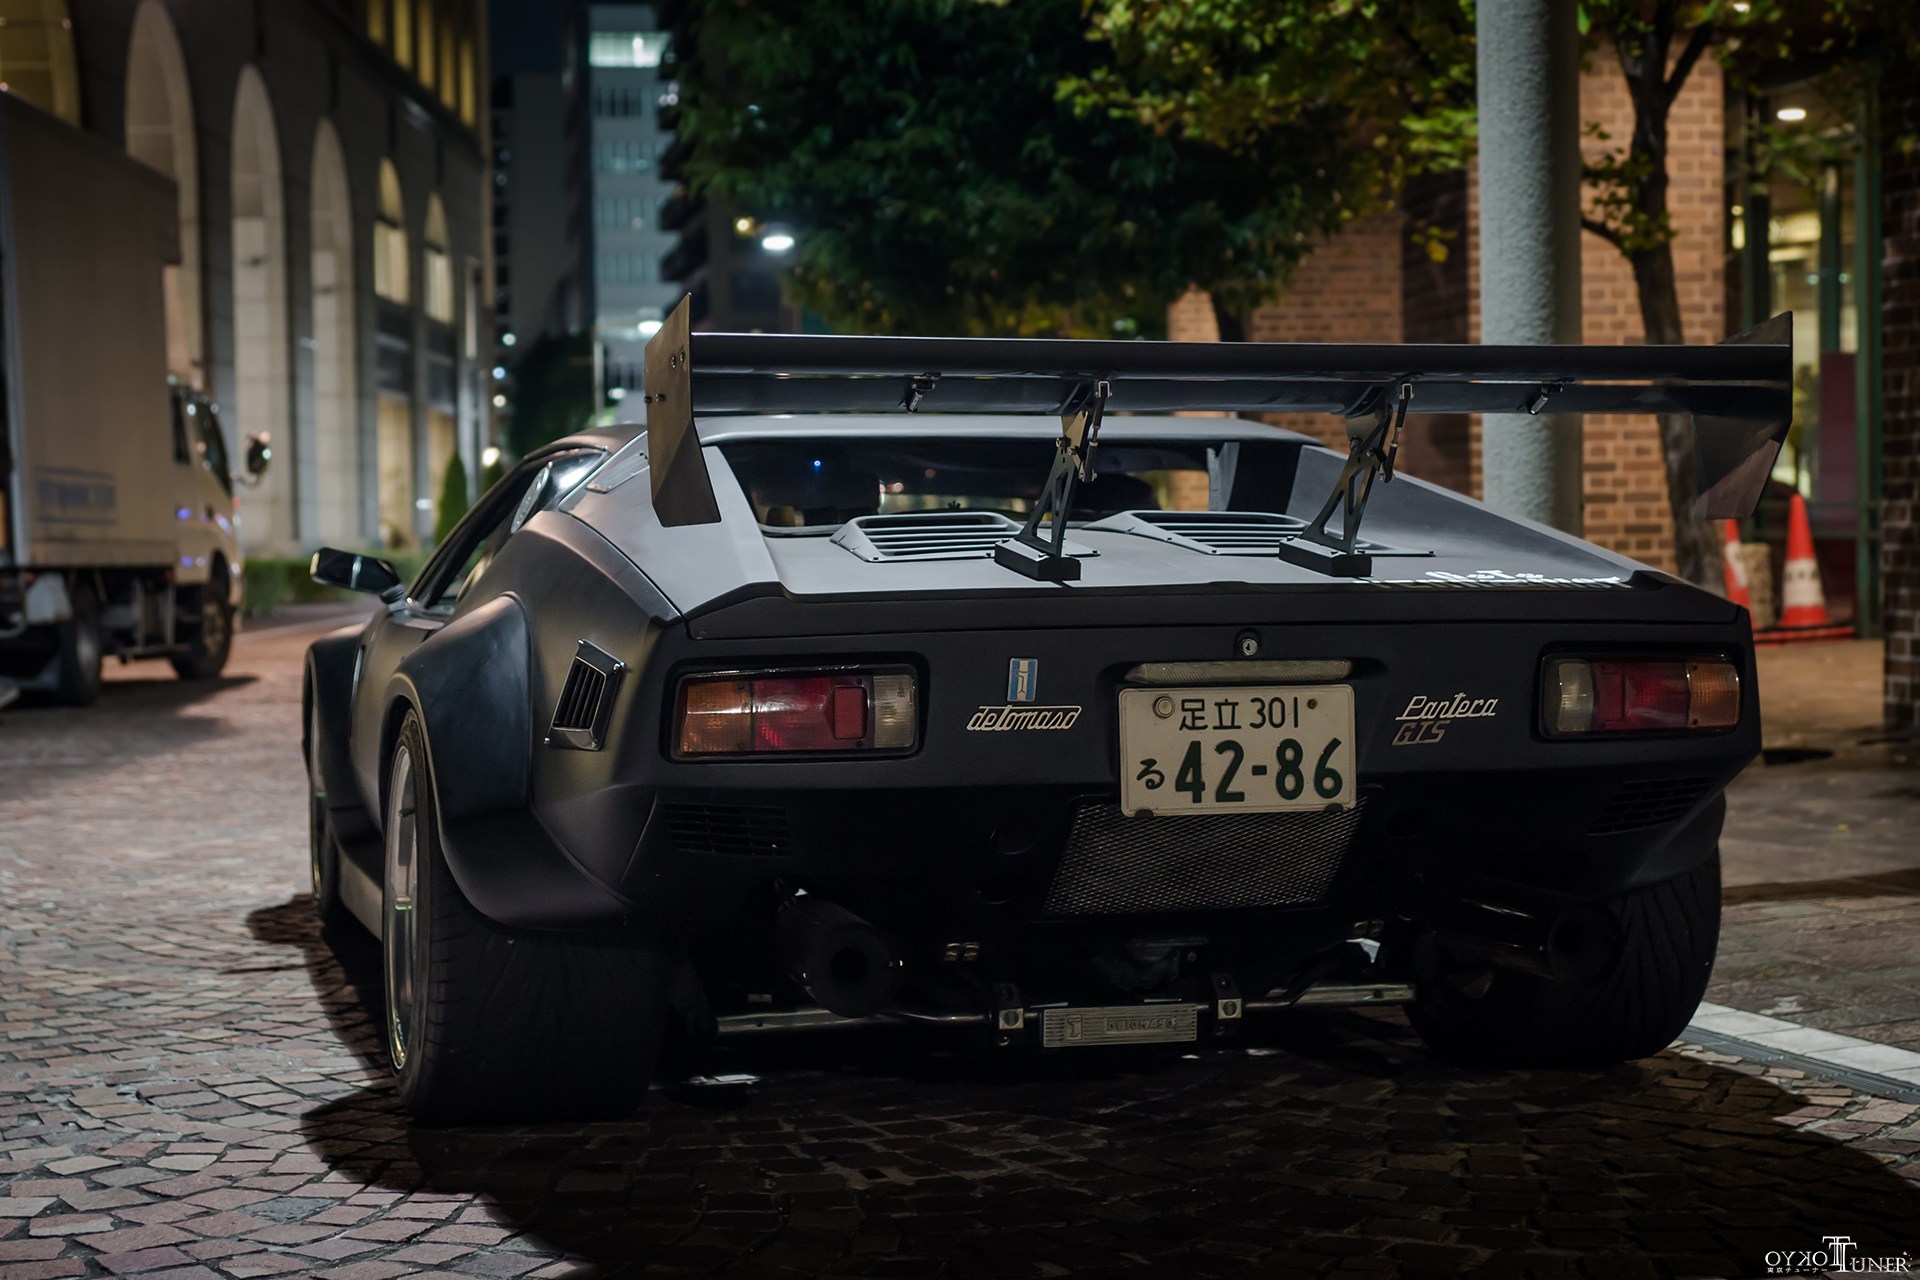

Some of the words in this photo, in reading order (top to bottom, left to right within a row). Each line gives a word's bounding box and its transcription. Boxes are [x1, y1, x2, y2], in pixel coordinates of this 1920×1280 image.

[1395, 692, 1498, 720] Pantera
[1392, 720, 1452, 746] GTS
[1136, 758, 1165, 790] る
[1175, 737, 1343, 803] 42-86
